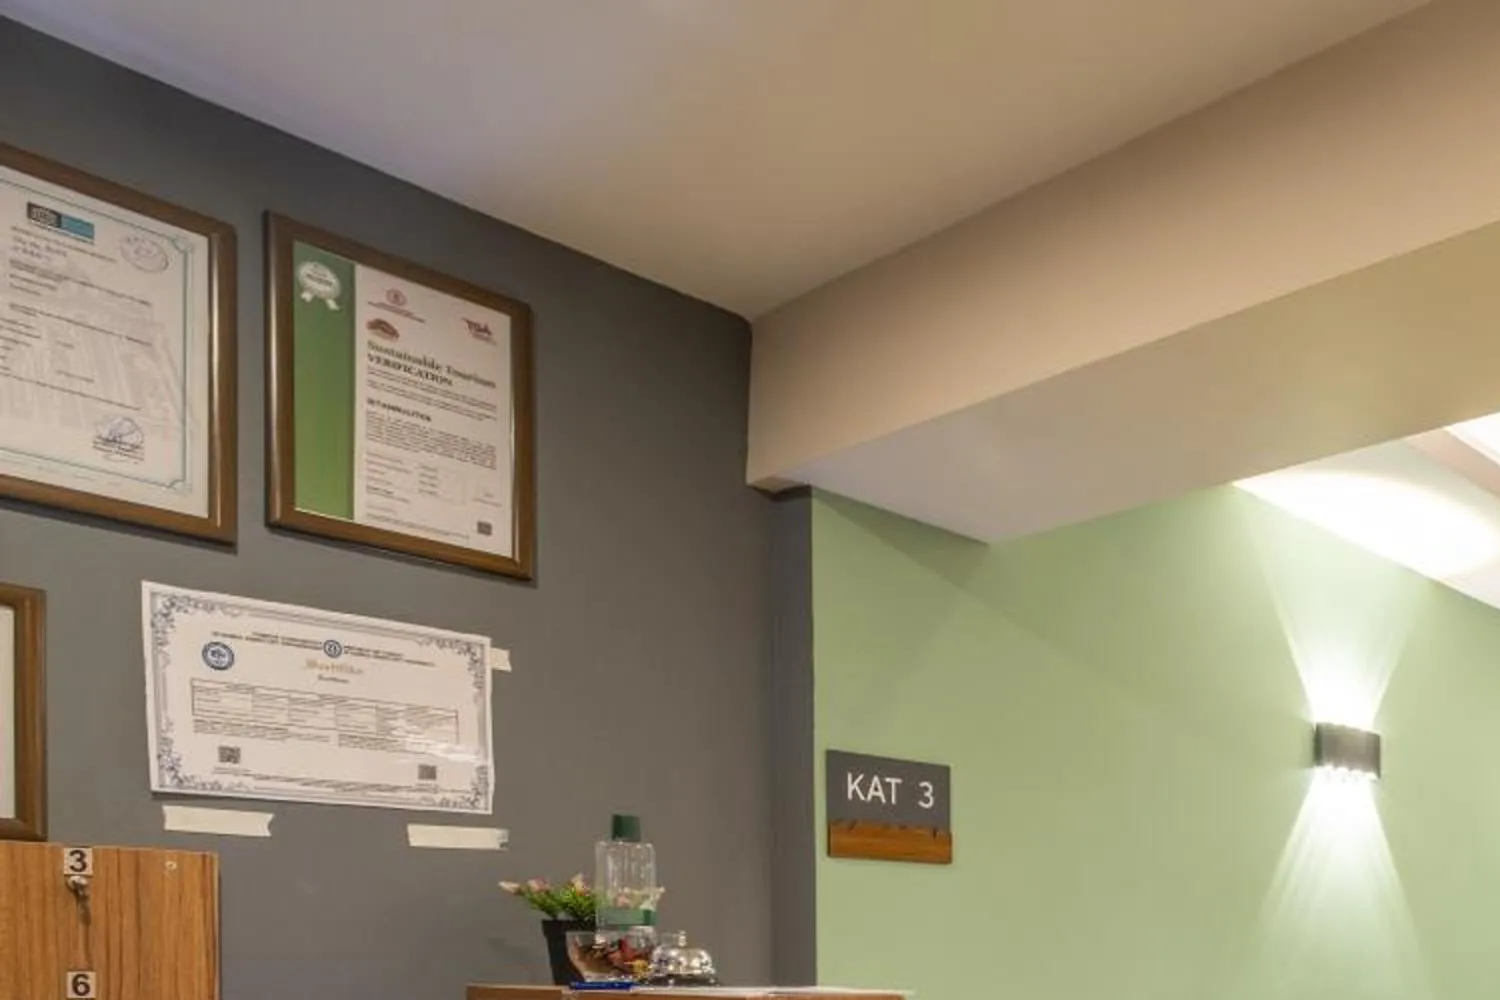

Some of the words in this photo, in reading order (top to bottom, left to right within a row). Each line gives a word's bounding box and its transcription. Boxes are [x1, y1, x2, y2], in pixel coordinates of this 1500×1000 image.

[847, 771, 903, 805] KAT
[918, 781, 935, 809] 3
[69, 849, 88, 873] 3
[71, 973, 91, 997] 6
